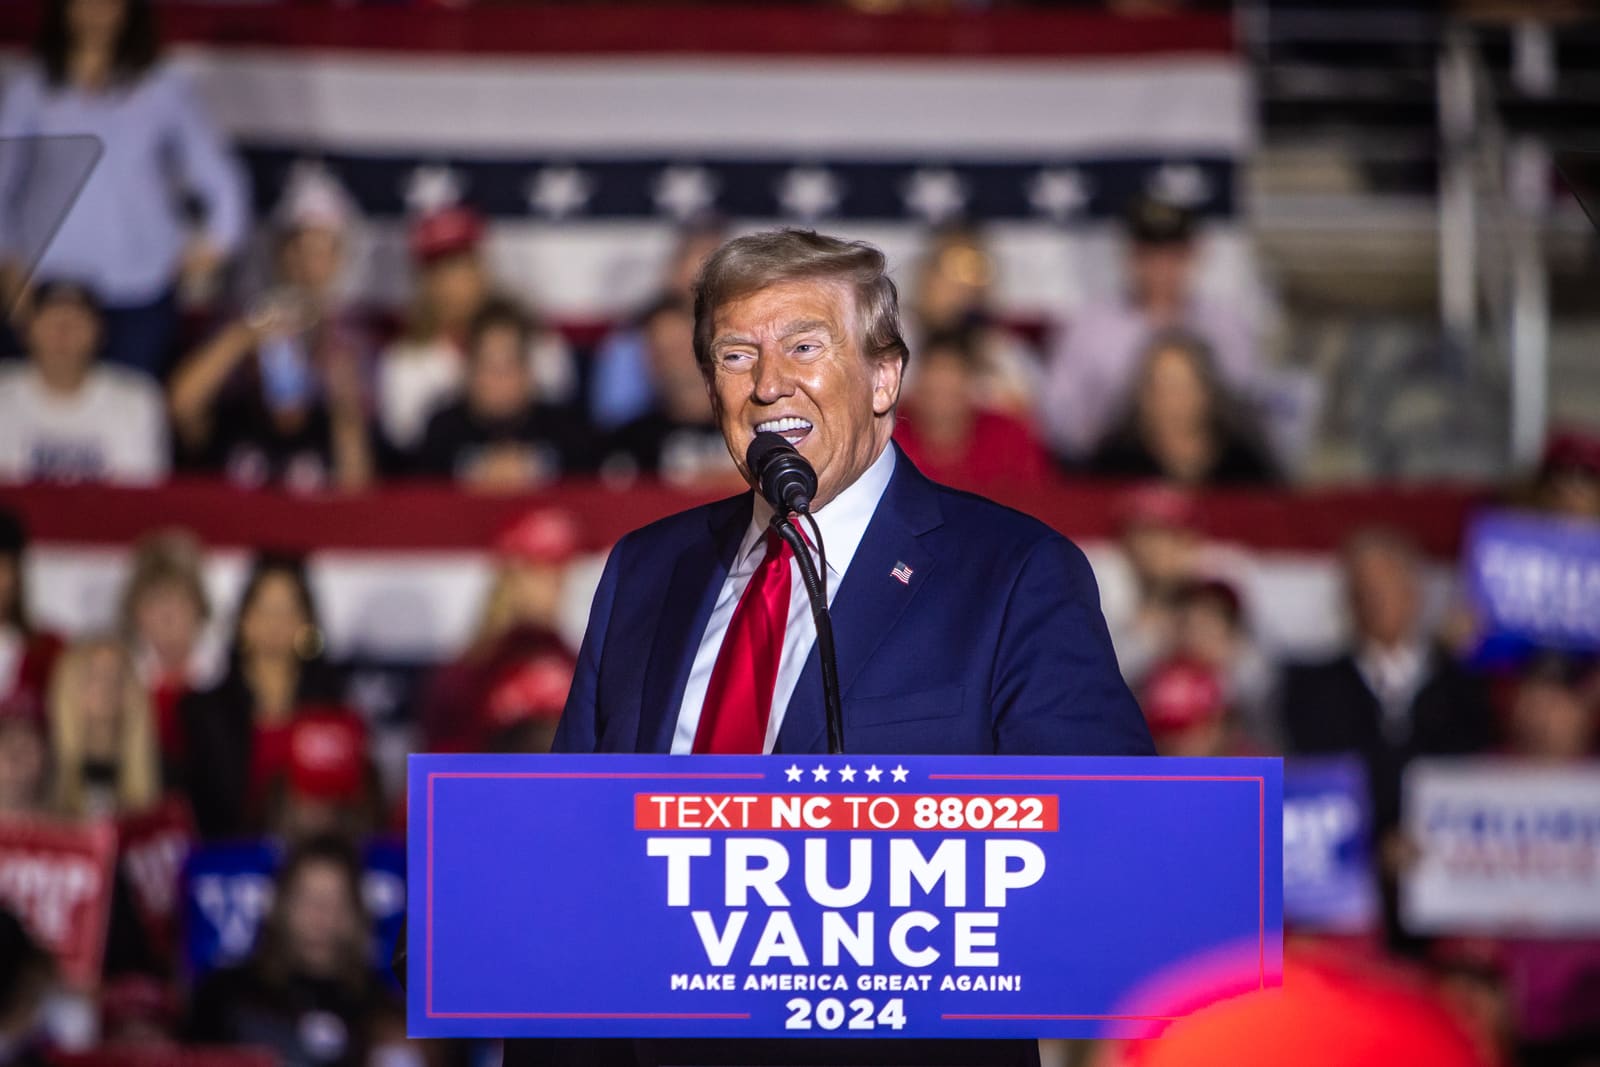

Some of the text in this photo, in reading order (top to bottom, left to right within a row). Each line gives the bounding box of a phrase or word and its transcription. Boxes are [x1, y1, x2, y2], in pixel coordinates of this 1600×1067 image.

[650, 795, 1044, 830] TEXT NC TO 88022
[647, 837, 1047, 908] TRUMP
[691, 910, 1000, 968] VANCE
[670, 973, 1021, 992] MAKE AMERICA GREAT AGAIN!
[785, 997, 907, 1030] 2024
